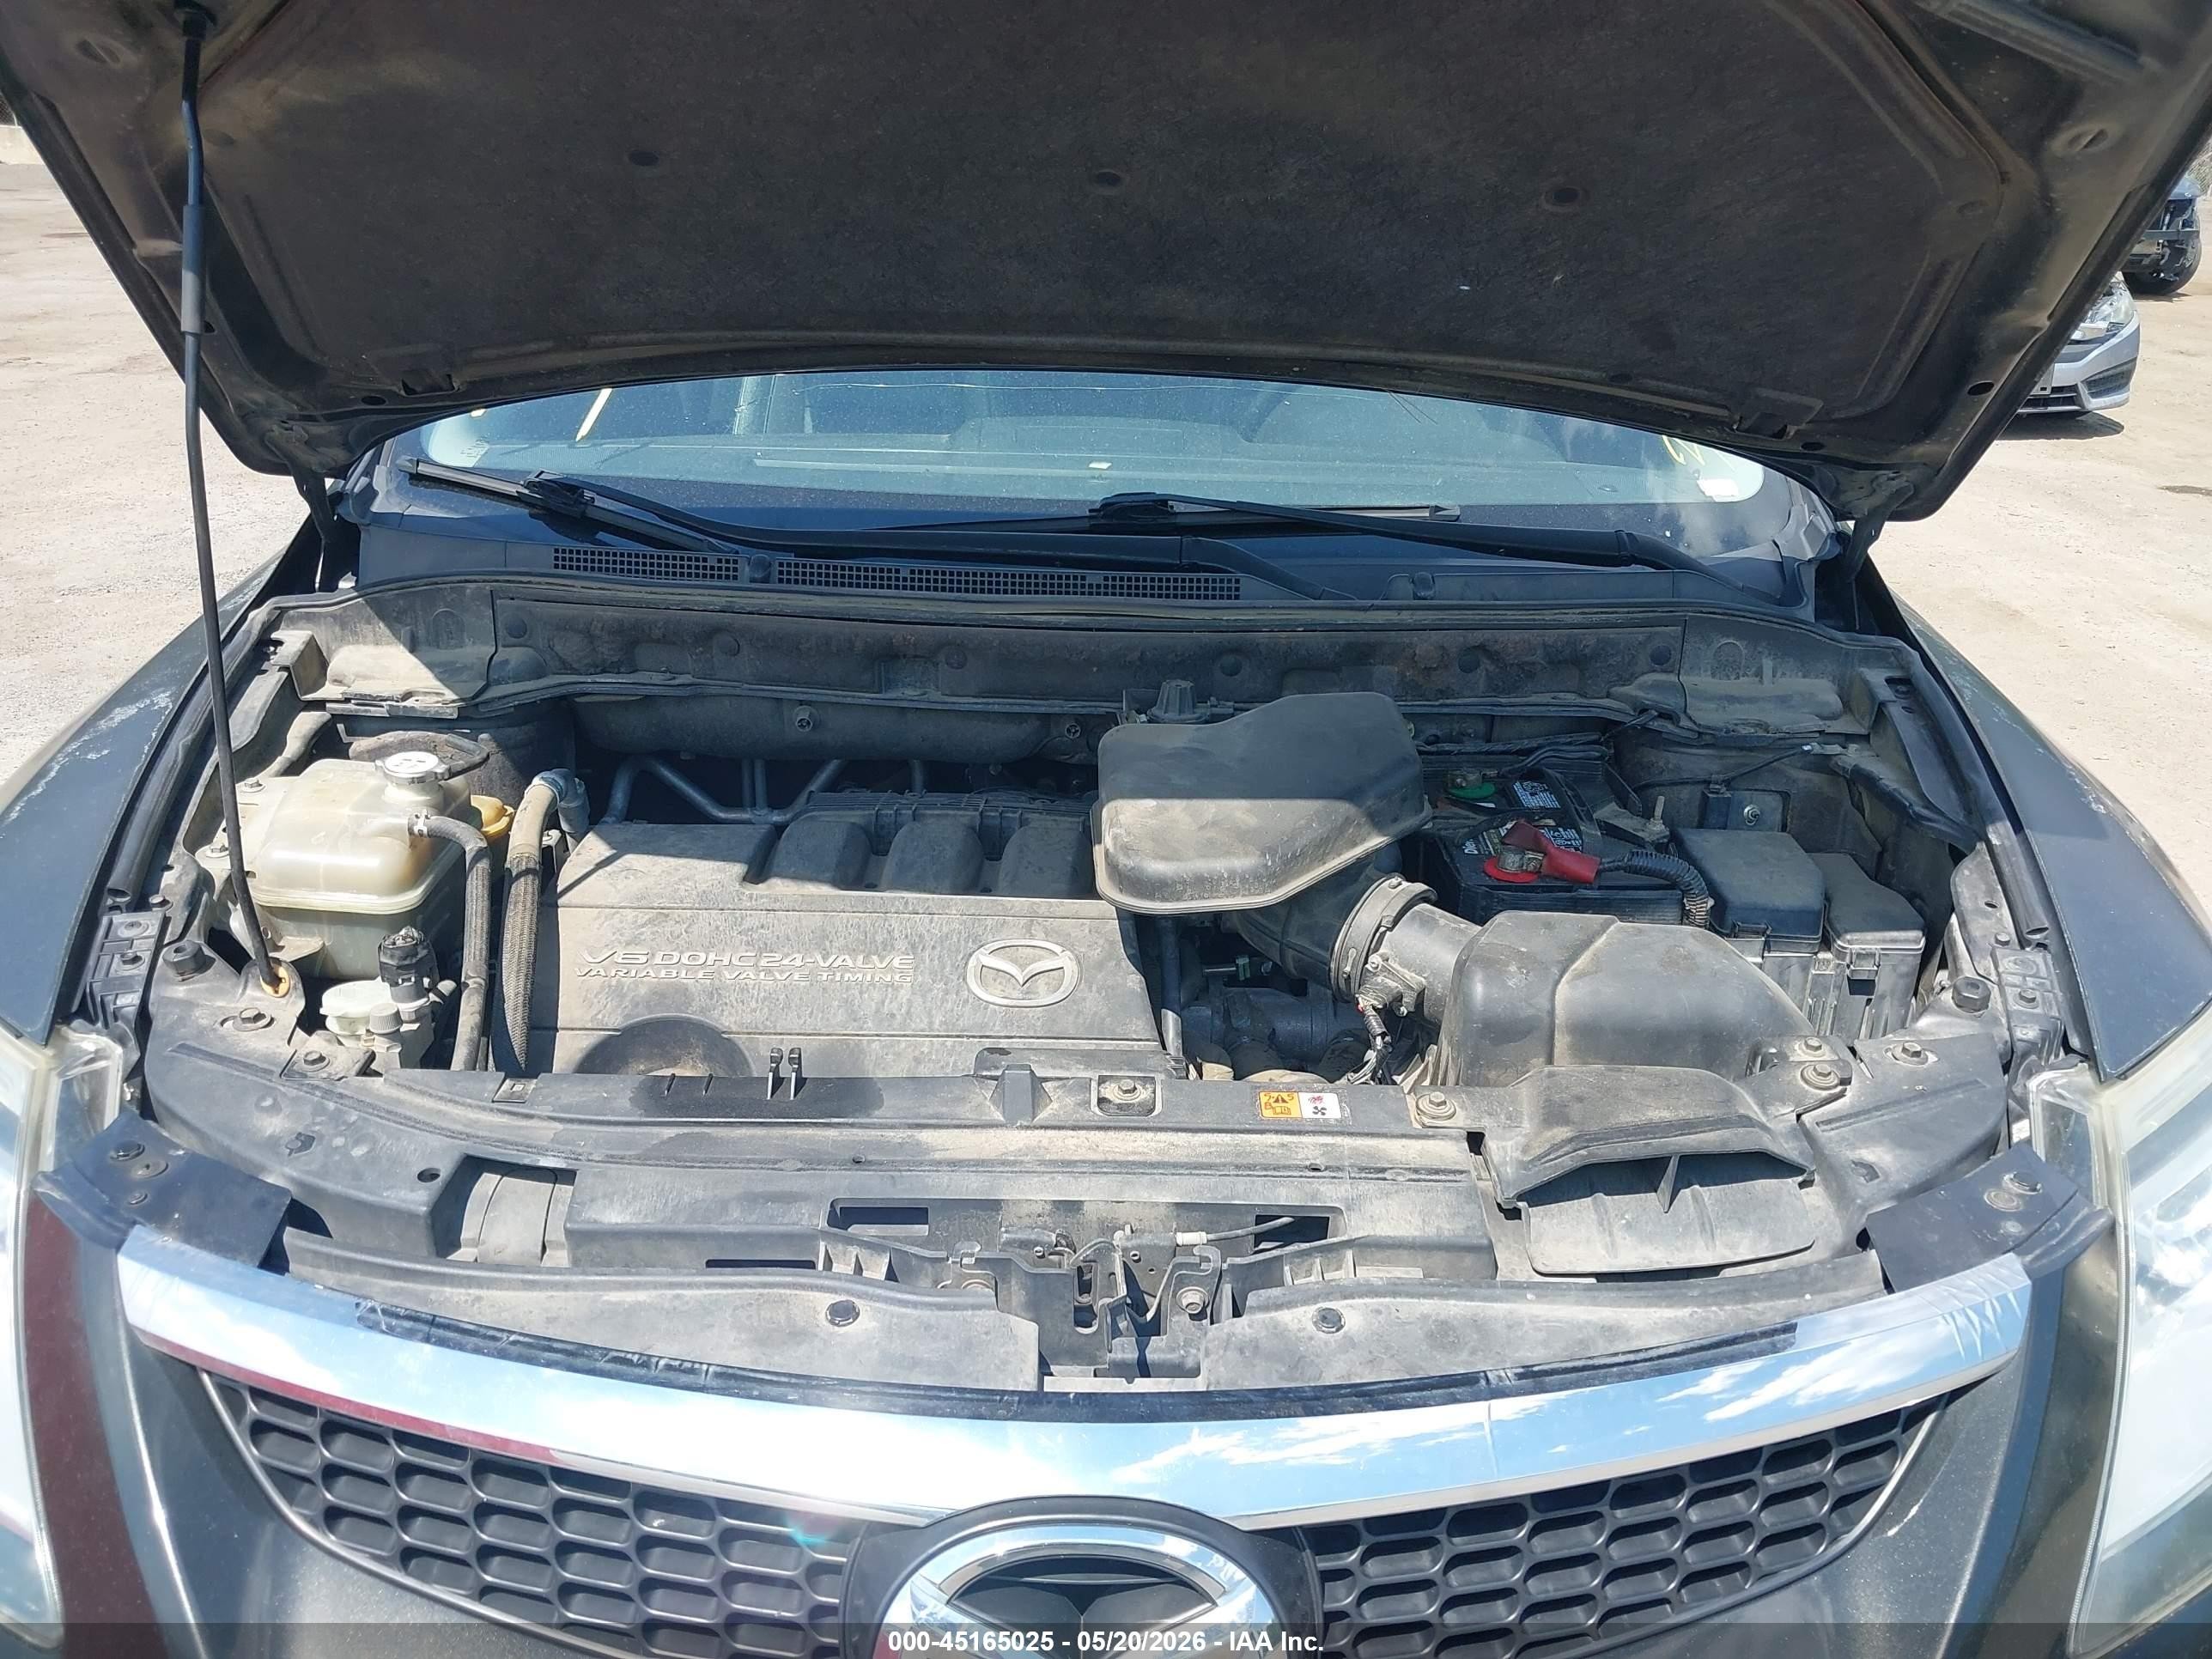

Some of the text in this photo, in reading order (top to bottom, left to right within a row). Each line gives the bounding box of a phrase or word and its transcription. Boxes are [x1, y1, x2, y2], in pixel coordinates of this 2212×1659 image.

[578, 950, 915, 969] V6 DOHC 24-VALVE
[574, 967, 915, 983] VARIABLE VALVE TIMING
